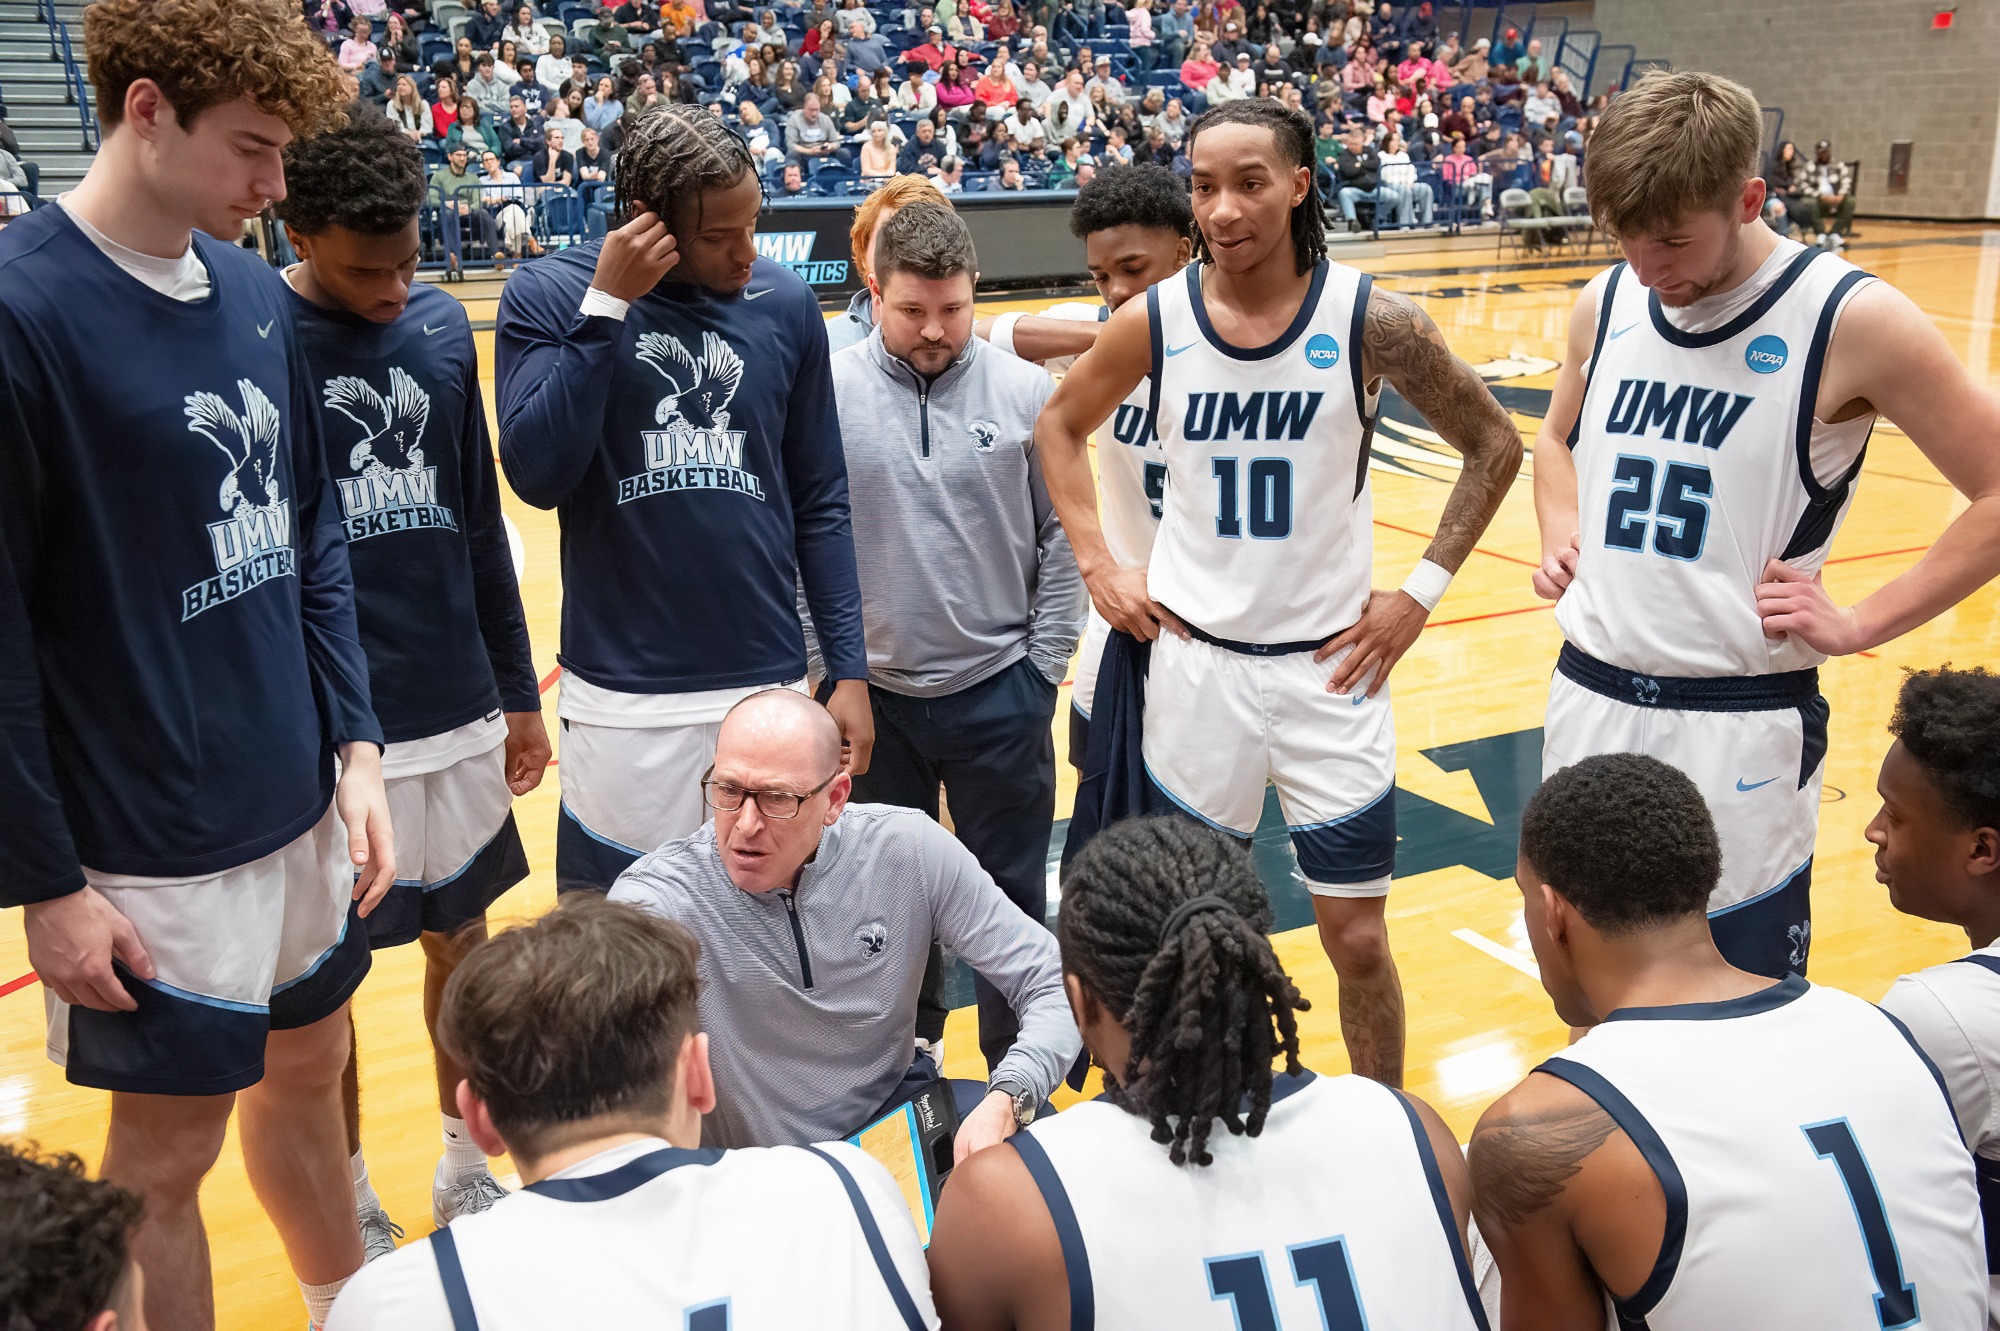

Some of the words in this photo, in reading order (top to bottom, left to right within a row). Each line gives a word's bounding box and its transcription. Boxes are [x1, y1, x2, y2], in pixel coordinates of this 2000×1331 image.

[1309, 349, 1337, 360] NCAA
[1750, 350, 1784, 366] NCAA
[1183, 391, 1325, 441] UMW
[1605, 379, 1756, 451] UMW
[643, 432, 743, 470] UMW
[340, 468, 437, 518] UMW
[620, 466, 766, 500] BASKETBALL
[1211, 456, 1293, 541] 10
[1604, 453, 1713, 562] 25
[210, 501, 289, 571] UMW
[342, 506, 459, 541] SKETBALL
[1798, 1116, 1921, 1331] 1
